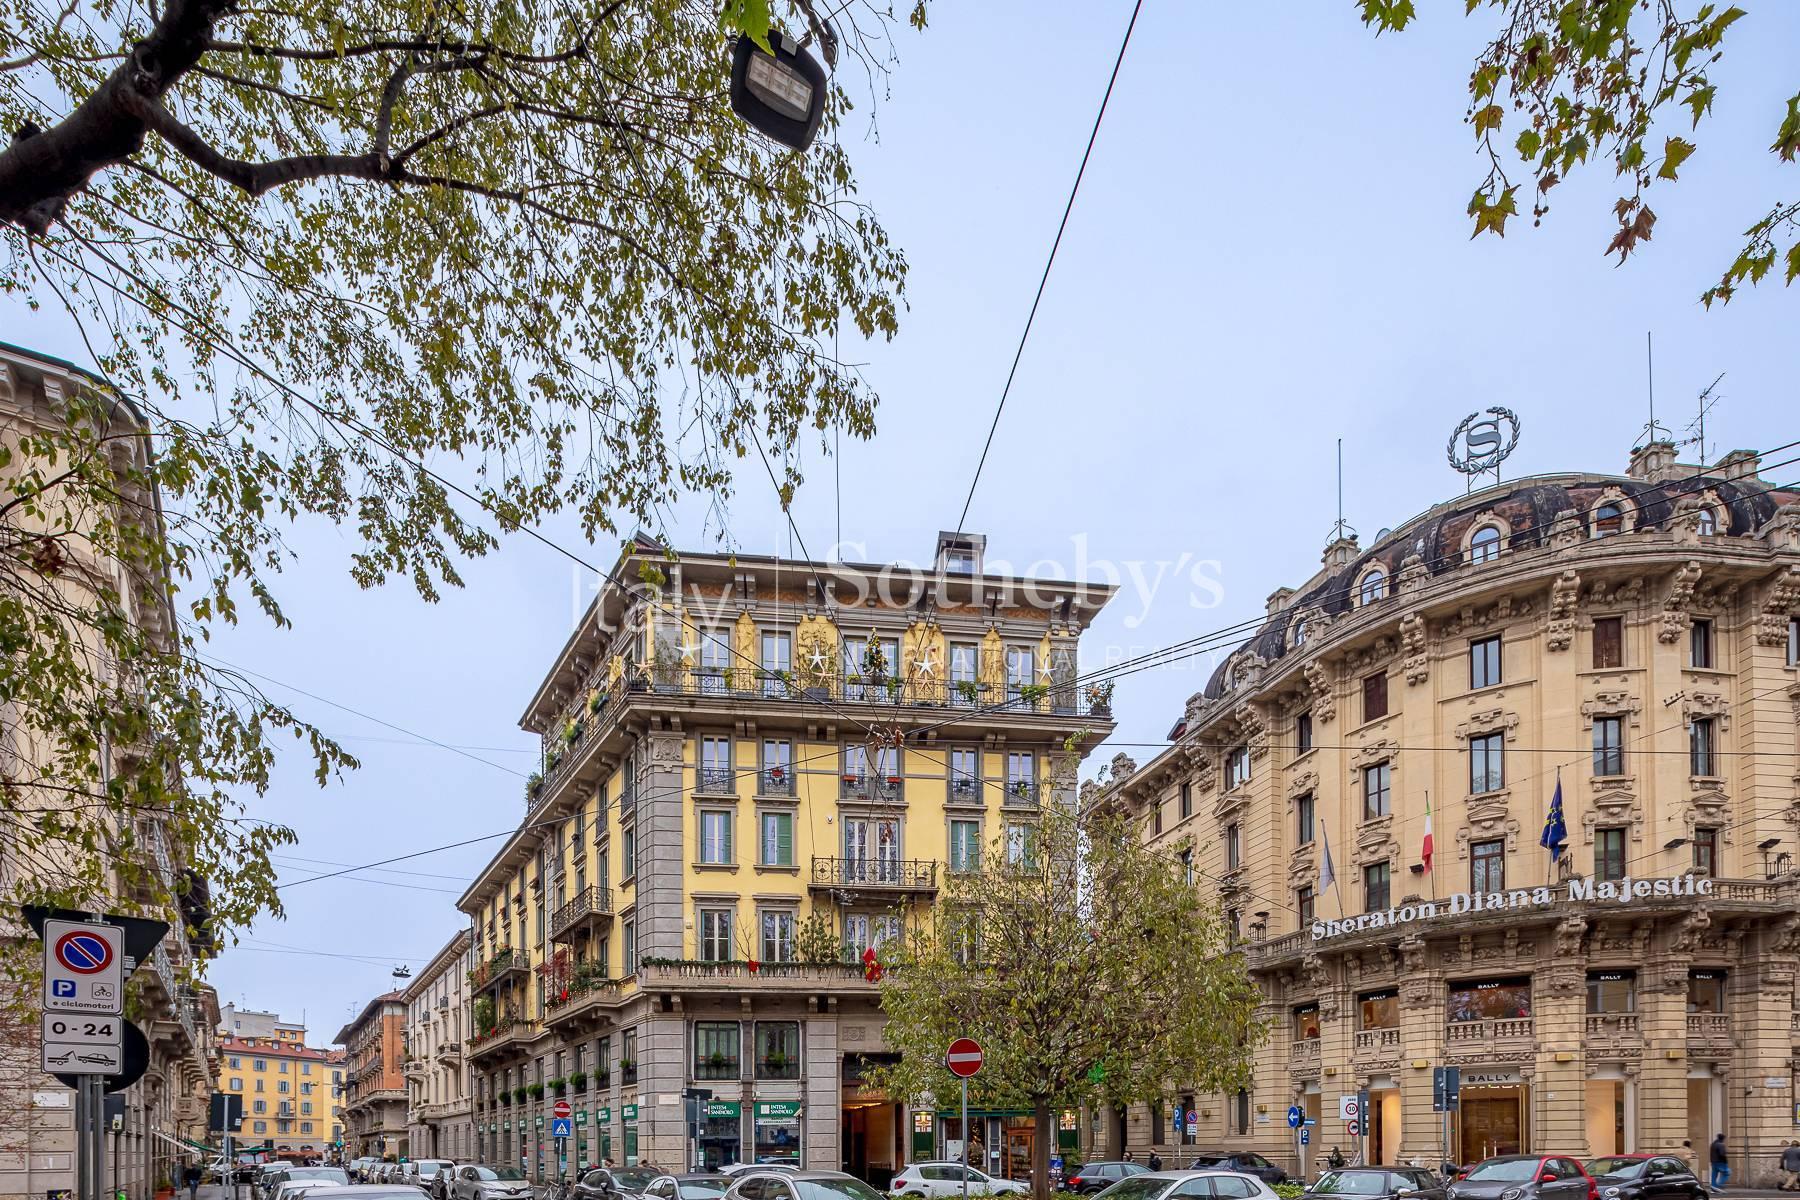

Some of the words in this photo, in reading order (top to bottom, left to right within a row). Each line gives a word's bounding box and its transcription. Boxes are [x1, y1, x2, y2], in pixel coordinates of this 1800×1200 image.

[1466, 420, 1501, 461] S
[1312, 901, 1437, 941] Sheraton
[1449, 886, 1553, 915] Diana
[1567, 874, 1713, 903] Majestic
[57, 981, 72, 995] P
[61, 1000, 114, 1010] ciclomotori
[84, 1023, 113, 1037] 24
[1468, 1074, 1511, 1082] BALLY
